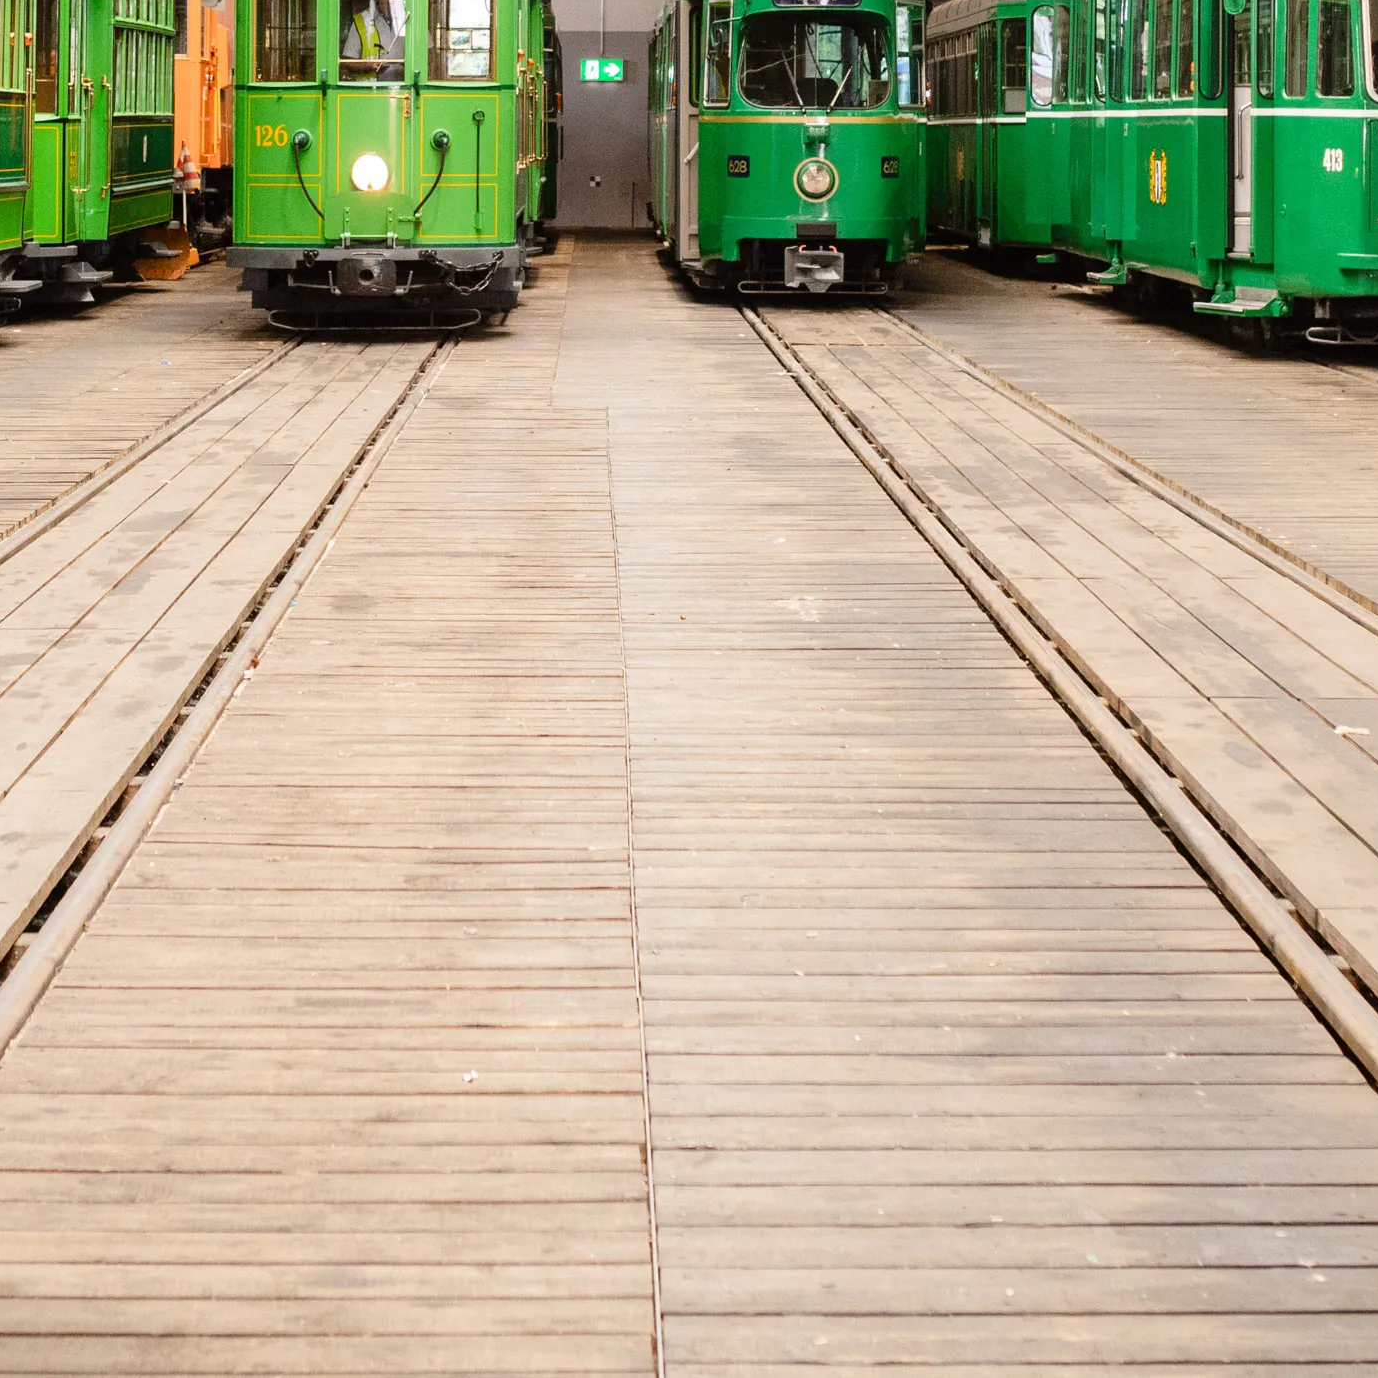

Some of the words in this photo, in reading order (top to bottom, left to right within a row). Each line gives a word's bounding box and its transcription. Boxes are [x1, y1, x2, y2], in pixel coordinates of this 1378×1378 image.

[255, 124, 289, 147] 126
[728, 160, 747, 173] 628
[1322, 148, 1343, 172] 413
